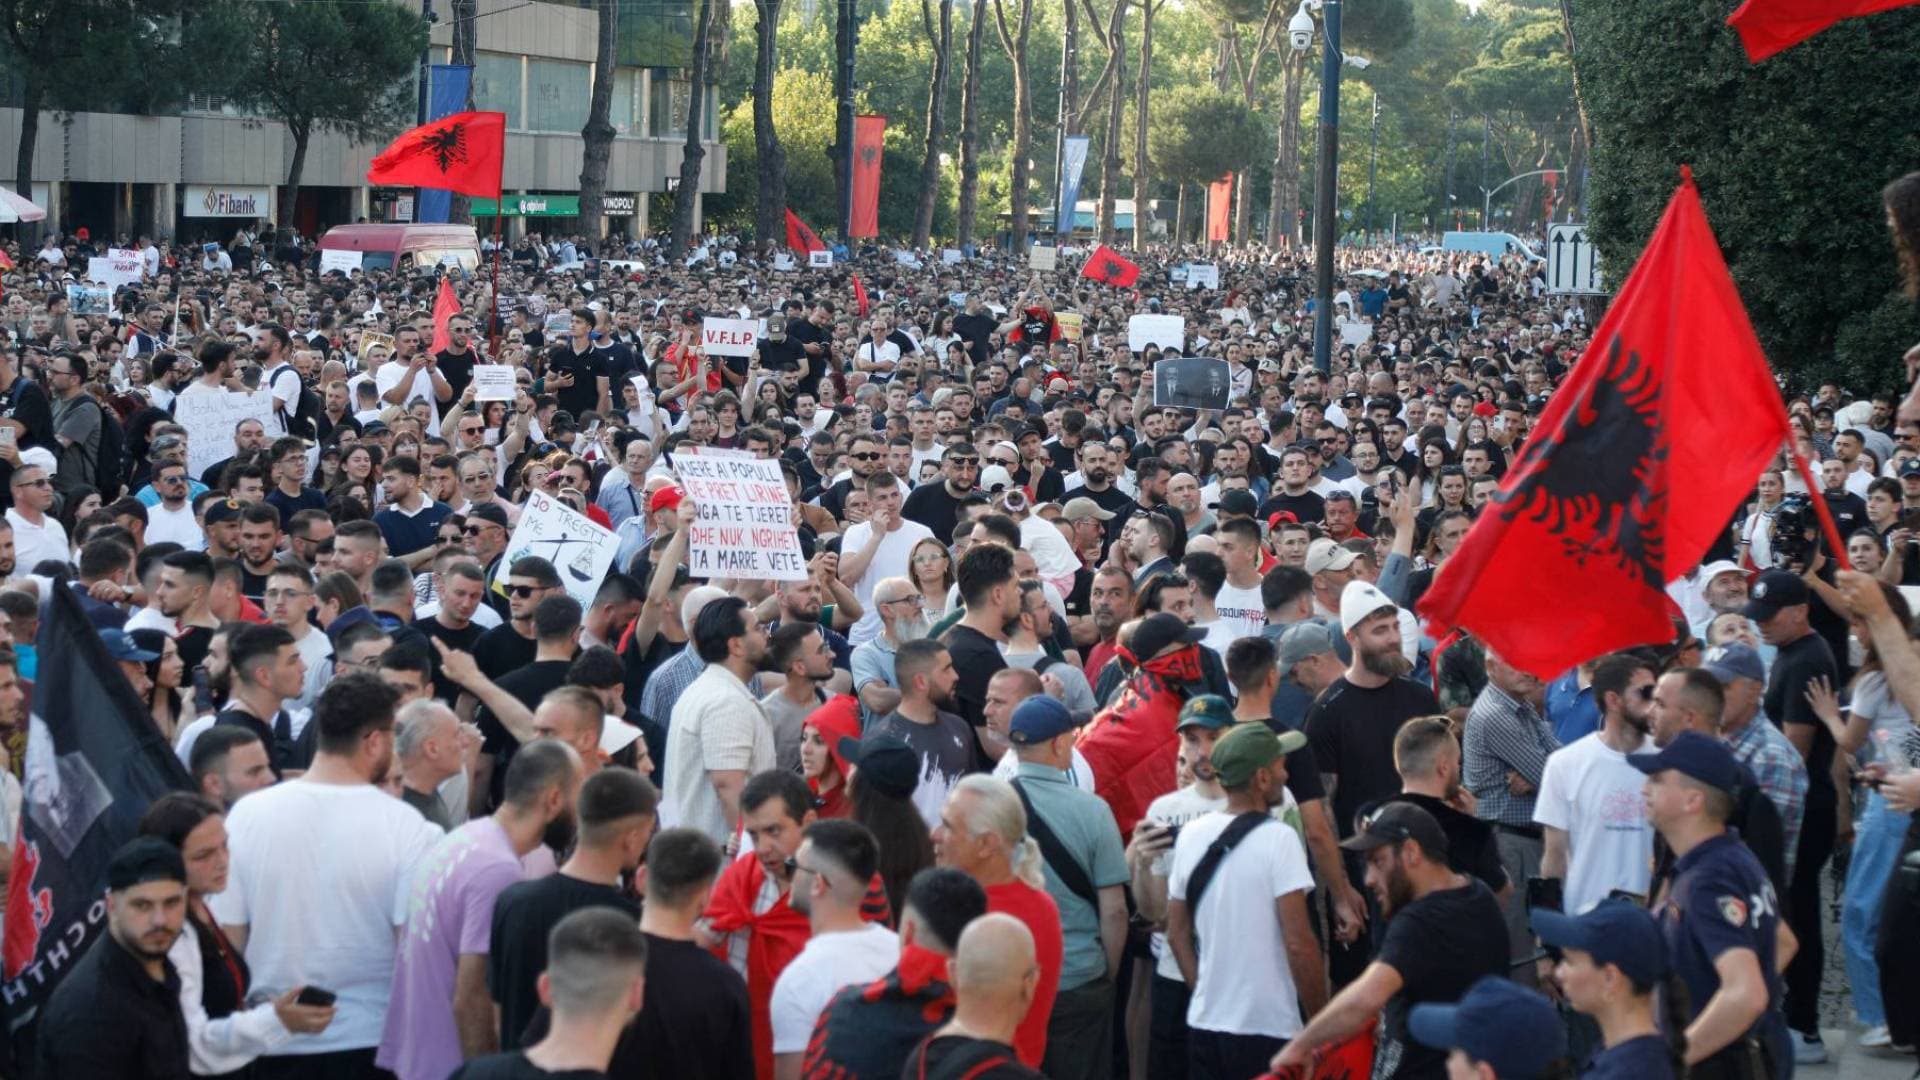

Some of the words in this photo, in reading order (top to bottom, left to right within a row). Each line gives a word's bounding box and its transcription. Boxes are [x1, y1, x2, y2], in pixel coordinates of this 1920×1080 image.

[218, 194, 256, 214] Fibank
[603, 197, 635, 209] VINOPOLY
[706, 330, 753, 346] V.F.L.P.
[730, 462, 780, 482] POPULL
[706, 482, 740, 501] PRET
[744, 484, 788, 504] LIRINE
[724, 505, 742, 521] TE
[746, 506, 789, 524] TJERET
[525, 515, 545, 536] ME
[691, 527, 714, 545] DHE
[720, 527, 744, 547] NUK
[752, 528, 798, 550] NGRIHET
[692, 549, 708, 569] TA
[718, 549, 758, 570] MARRE
[767, 552, 800, 571] VETE
